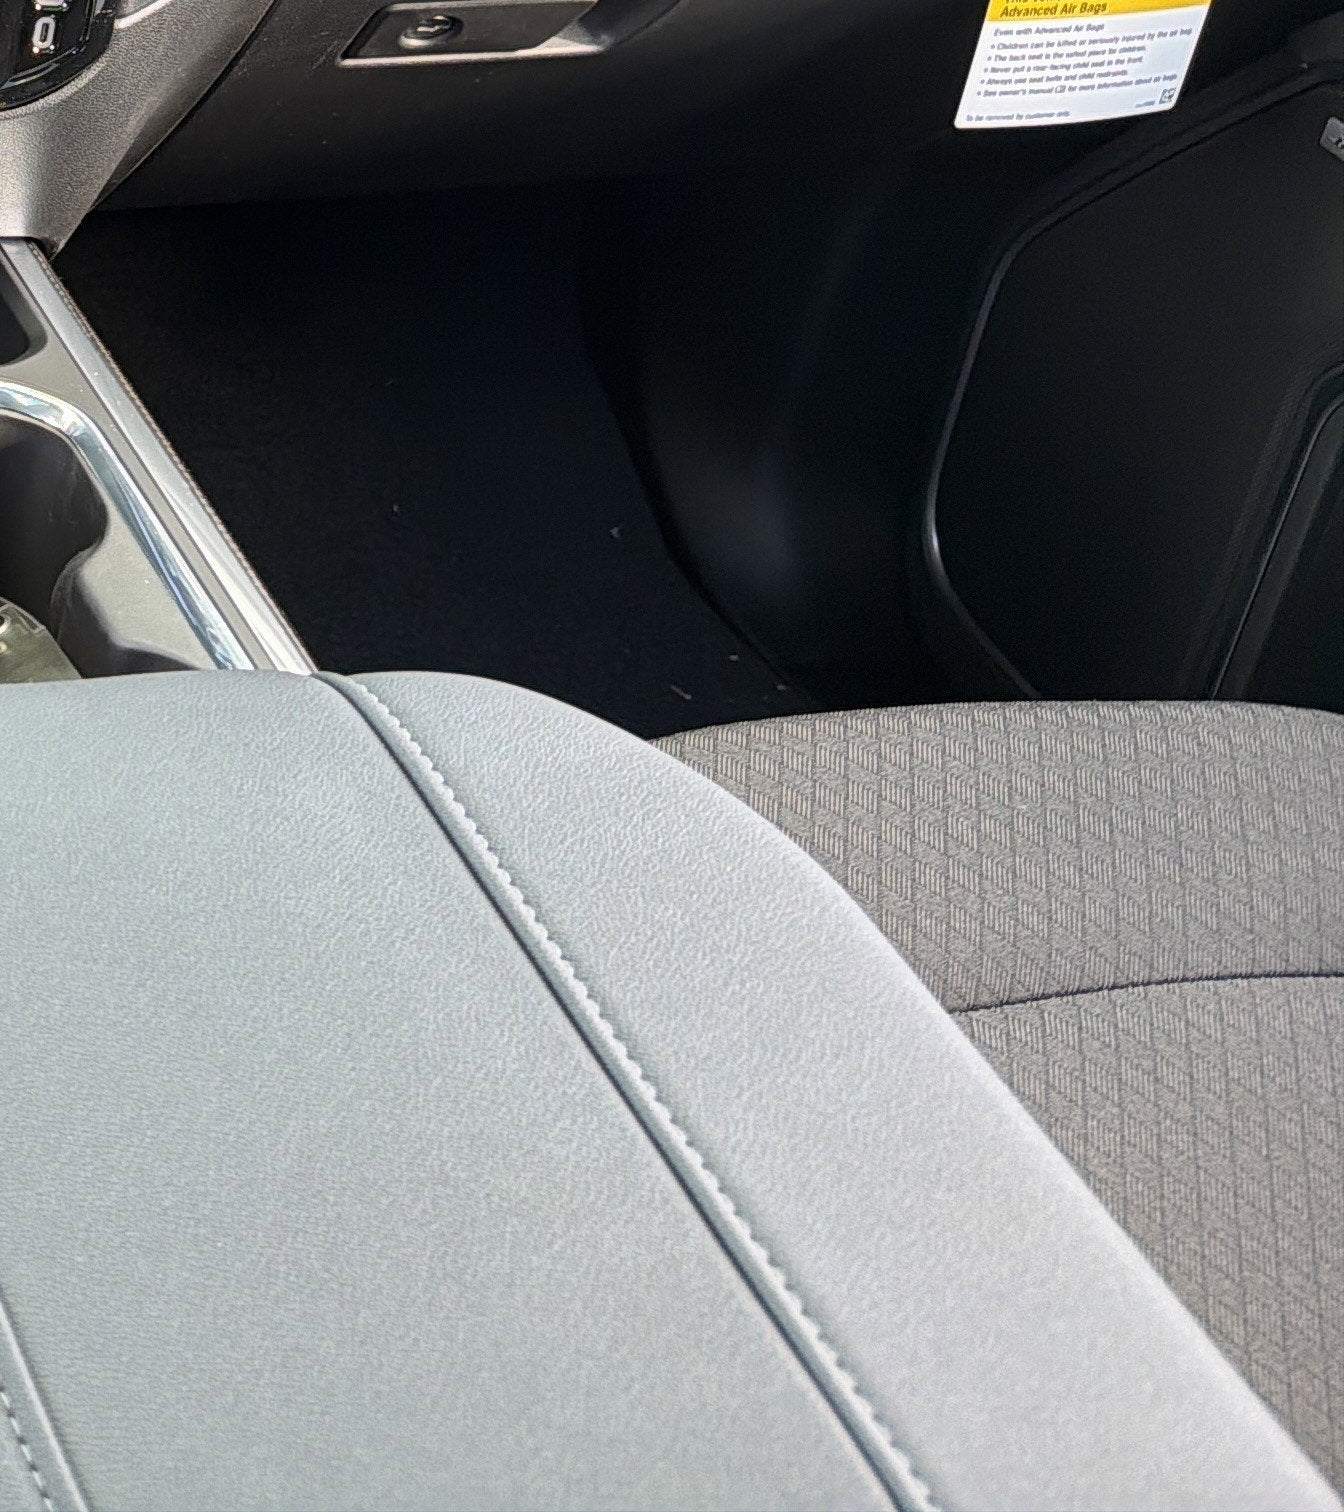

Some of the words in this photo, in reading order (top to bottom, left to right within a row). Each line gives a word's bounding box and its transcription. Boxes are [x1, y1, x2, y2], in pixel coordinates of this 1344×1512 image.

[1000, 3, 1057, 19] Advanced
[1060, 2, 1077, 15] Air
[1079, 1, 1108, 16] Bags
[994, 28, 1014, 37] Even
[1034, 25, 1072, 35] Advanced
